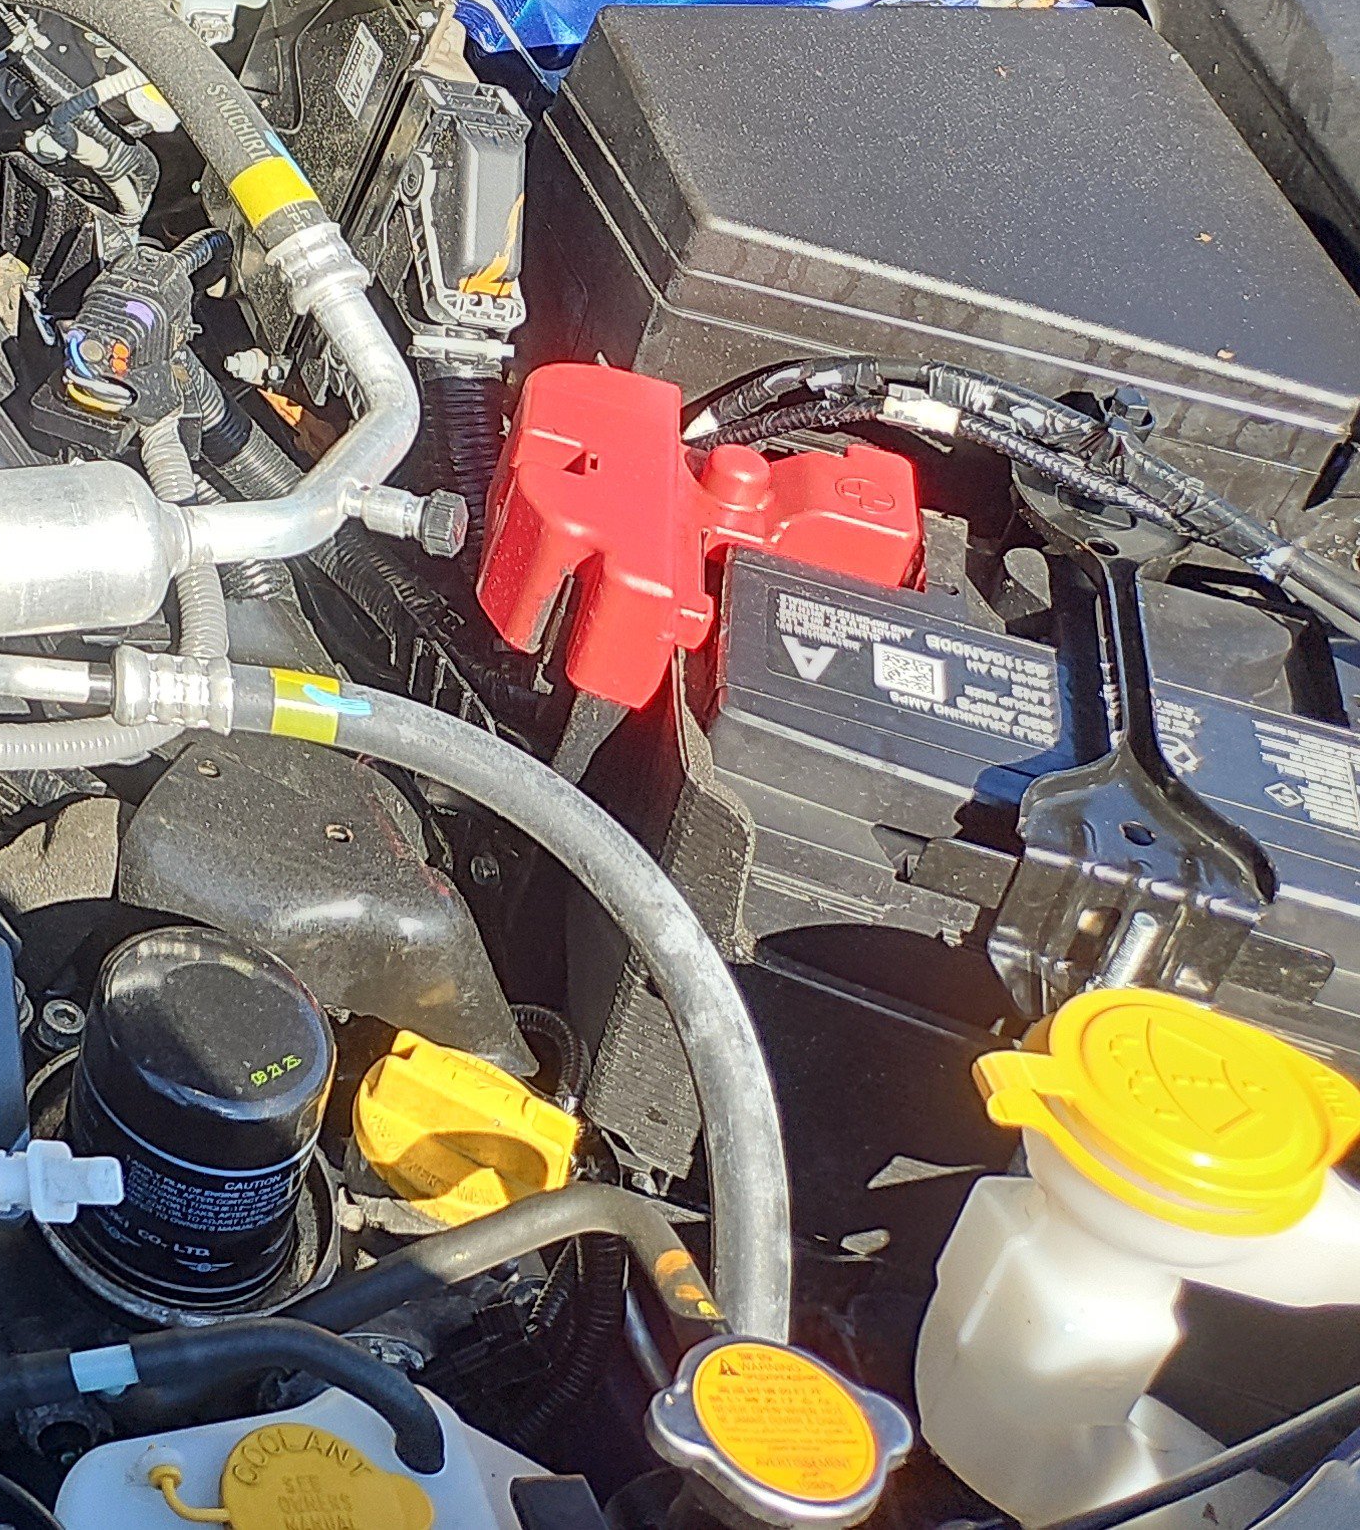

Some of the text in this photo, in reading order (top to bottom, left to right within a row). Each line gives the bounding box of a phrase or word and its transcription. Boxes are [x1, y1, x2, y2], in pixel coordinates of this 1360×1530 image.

[889, 690, 932, 713] AMPS
[956, 696, 1016, 723] AMPS
[224, 1173, 282, 1191] CAUTION
[232, 1428, 374, 1487] COOLANT
